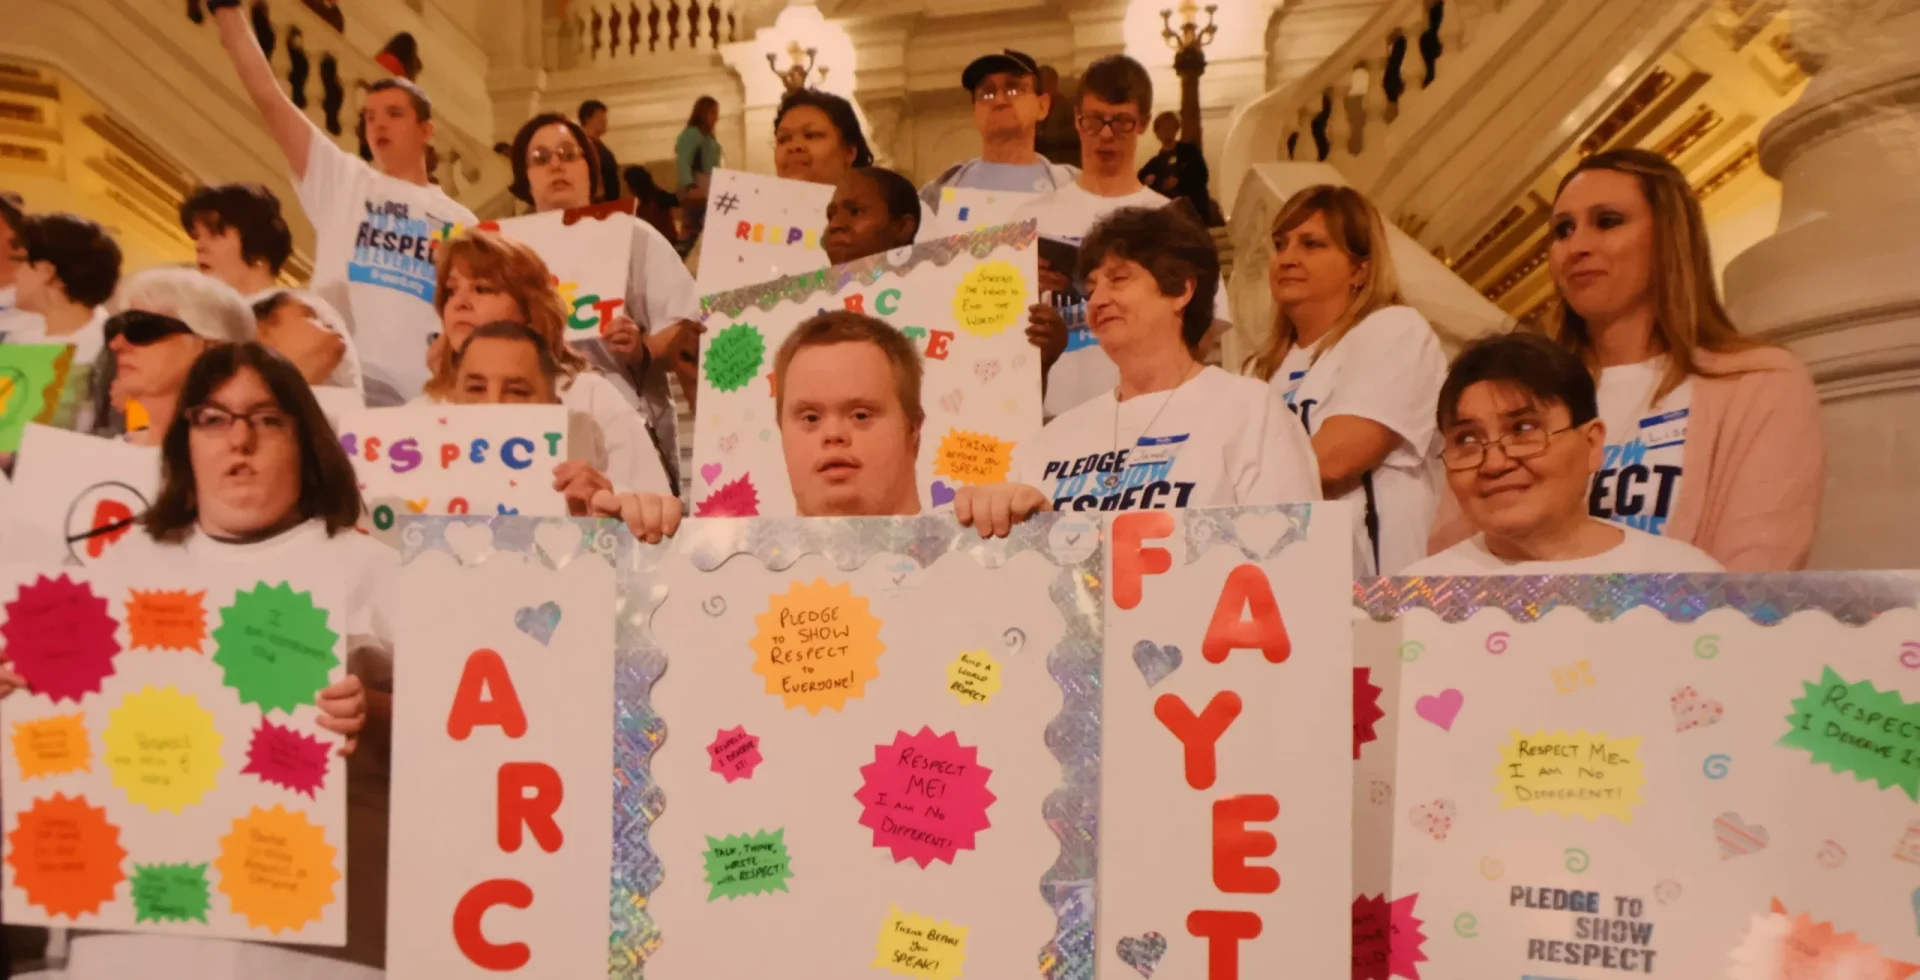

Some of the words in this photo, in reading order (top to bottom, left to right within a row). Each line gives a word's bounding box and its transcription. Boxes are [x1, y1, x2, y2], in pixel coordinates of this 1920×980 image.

[1042, 449, 1131, 481] PLEDGE
[780, 606, 839, 628] PLEDGE
[772, 636, 785, 644] TO
[798, 624, 850, 643] SHOW
[771, 645, 848, 664] RESPECT
[801, 665, 815, 674] TO
[782, 669, 855, 693] EVERYONE!
[1800, 712, 1813, 731] I
[1518, 739, 1579, 758] RESPECT
[898, 746, 966, 776] RESPECT
[1508, 762, 1525, 779] I
[1538, 765, 1563, 776] AM
[905, 774, 946, 799] ME!
[1514, 784, 1623, 802] DIFFERENT!
[874, 792, 888, 806] I
[894, 802, 914, 813] AM
[880, 816, 953, 849] DIFFERENT!
[1510, 885, 1600, 914] PLEDGE
[1614, 896, 1643, 918] TO
[1576, 916, 1655, 946] SHOW
[891, 949, 940, 972] SPEAK!
[1527, 938, 1657, 974] RESPECT
